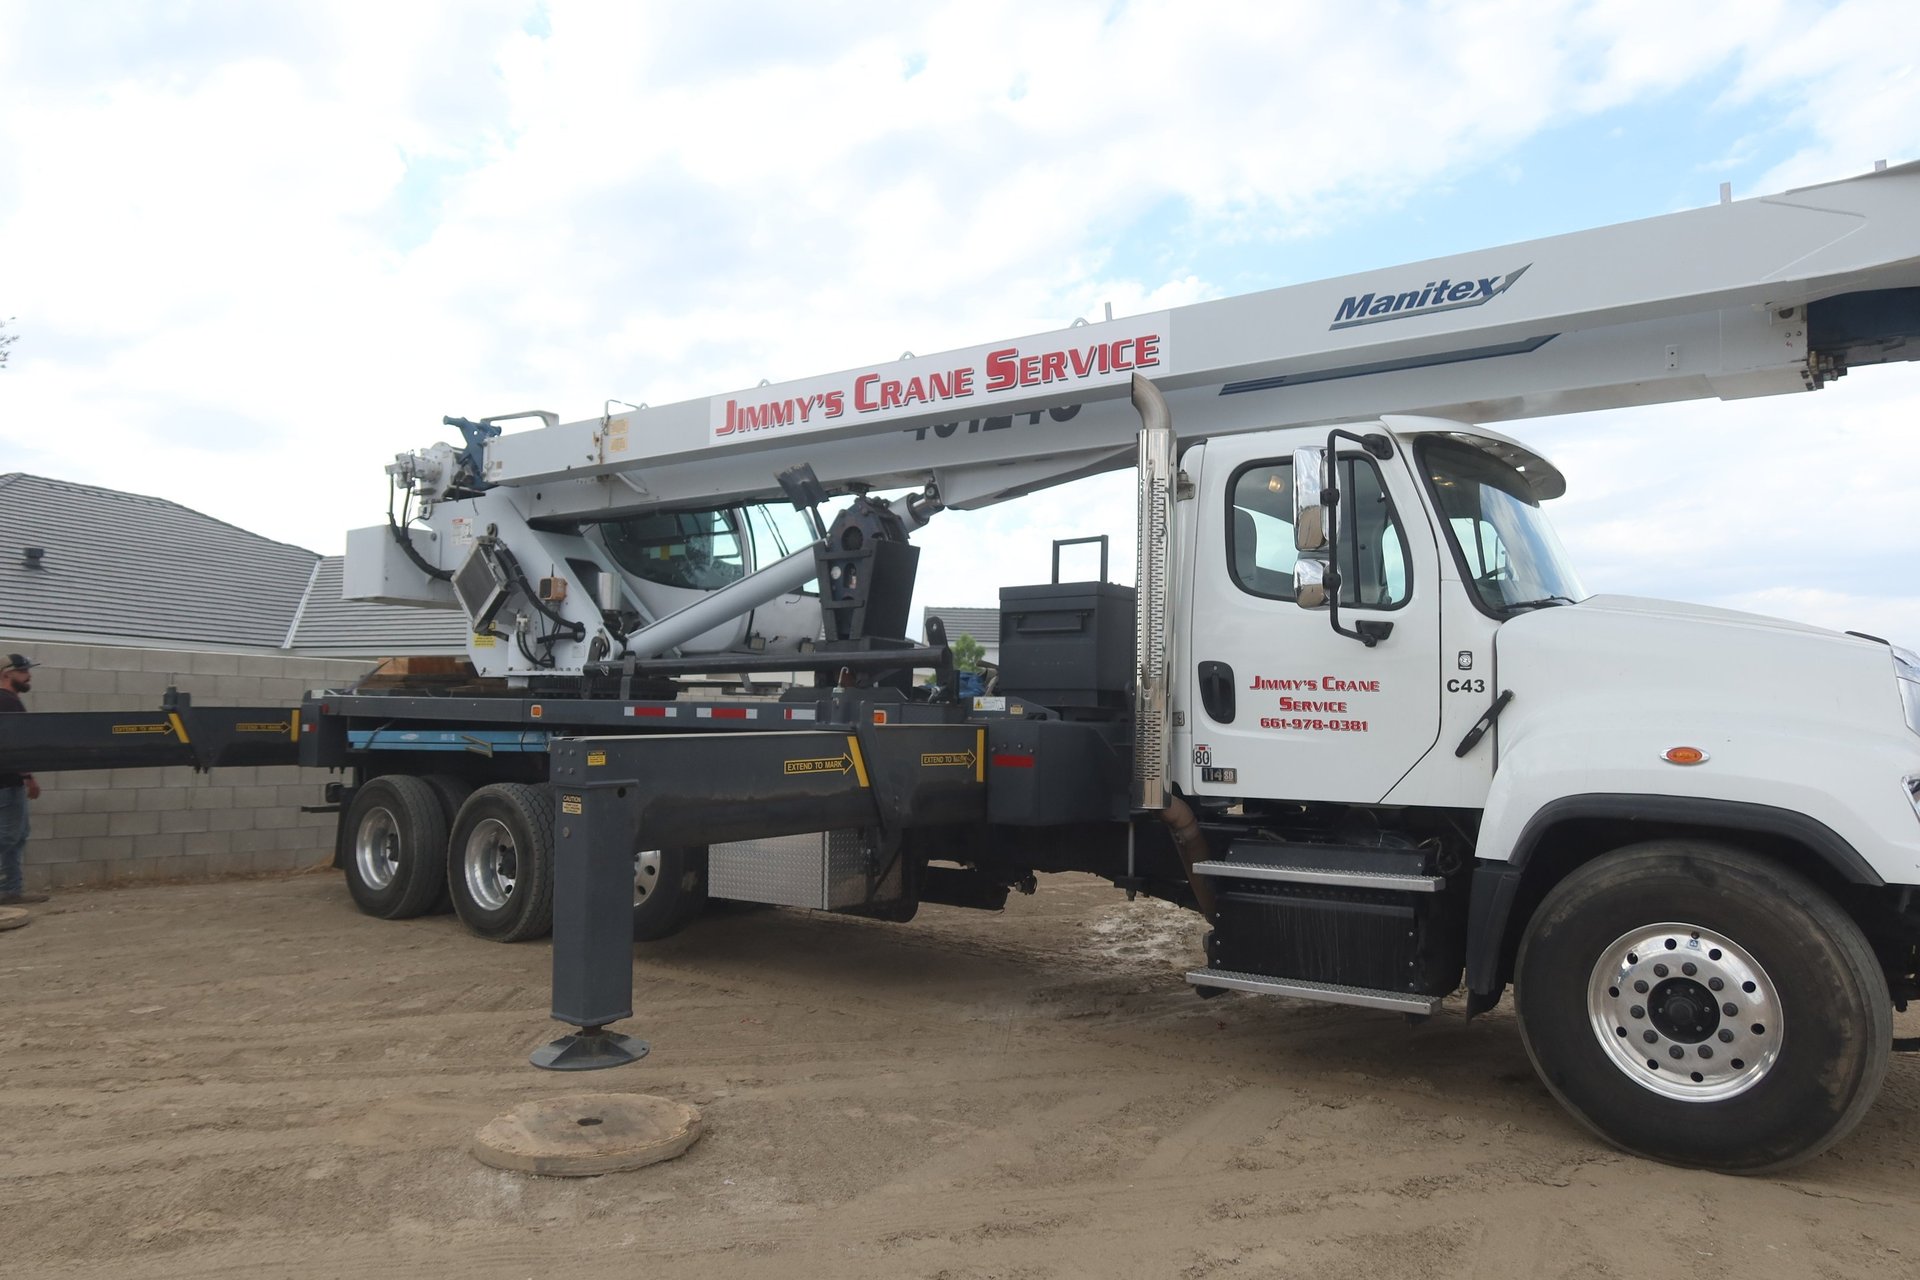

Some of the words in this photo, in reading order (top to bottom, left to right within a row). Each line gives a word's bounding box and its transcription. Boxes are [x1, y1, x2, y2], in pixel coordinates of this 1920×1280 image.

[1333, 276, 1501, 322] Manitex
[854, 367, 975, 413] CRANE
[985, 335, 1160, 391] SERVICE
[1322, 676, 1380, 692] CRANE
[1446, 679, 1485, 693] C43
[1279, 696, 1348, 713] SERVICE
[1260, 717, 1368, 732] 661-978-0381
[923, 756, 945, 764] EXTEND
[1195, 750, 1210, 765] 80
[787, 763, 813, 772] EXTEND
[815, 762, 825, 770] TO
[825, 760, 843, 769] MARK
